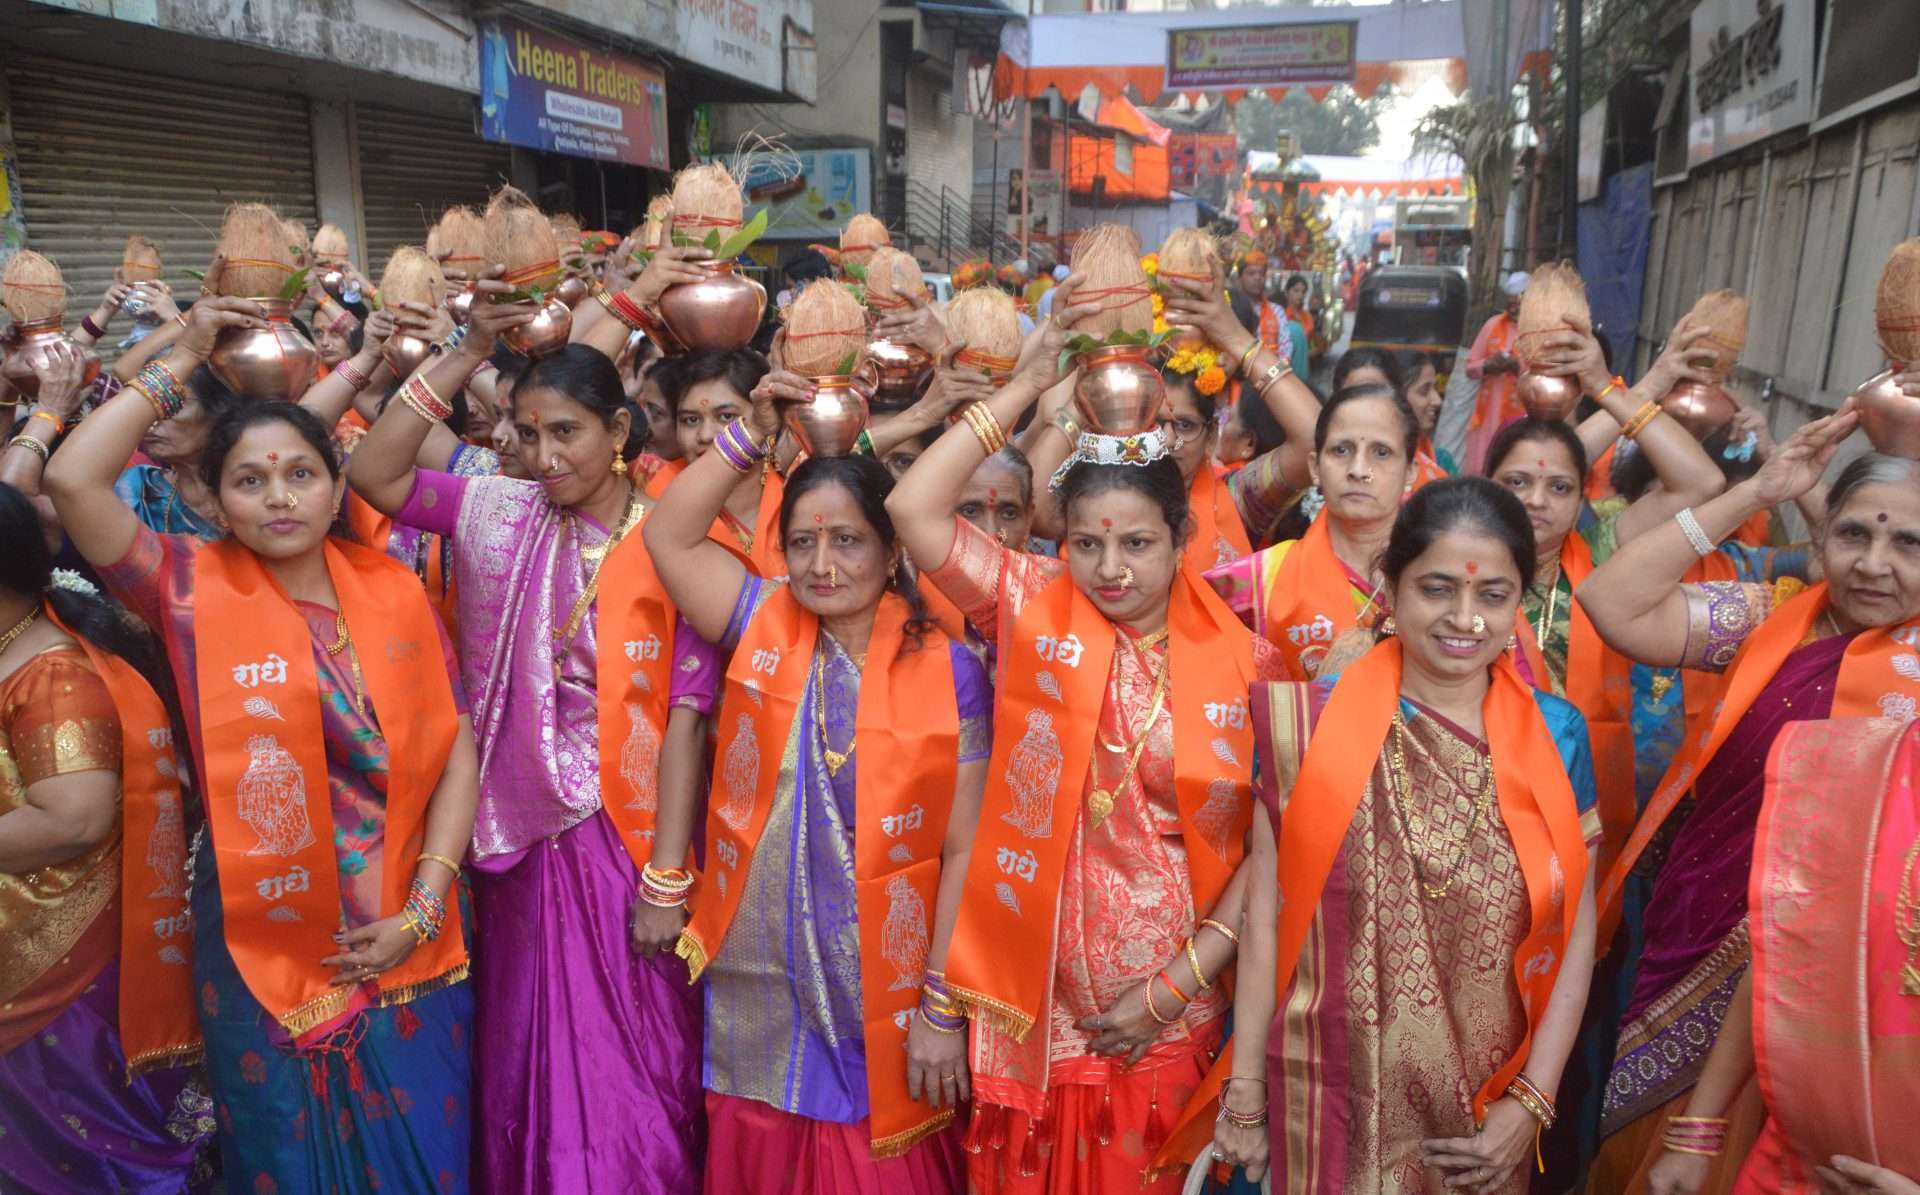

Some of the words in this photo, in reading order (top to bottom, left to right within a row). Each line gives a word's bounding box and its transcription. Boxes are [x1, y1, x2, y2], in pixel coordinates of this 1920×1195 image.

[516, 30, 577, 89] Heena
[580, 50, 641, 105] Traders
[551, 95, 585, 115] Wholesale
[624, 633, 662, 662] राधे
[1286, 614, 1334, 647] राधे
[751, 647, 781, 676] राधे
[1035, 633, 1085, 668] राधे
[232, 653, 289, 689] राधे
[1203, 697, 1247, 730] राधे
[880, 803, 924, 838] राधे
[997, 847, 1038, 882] राधे
[256, 865, 311, 901] राधे
